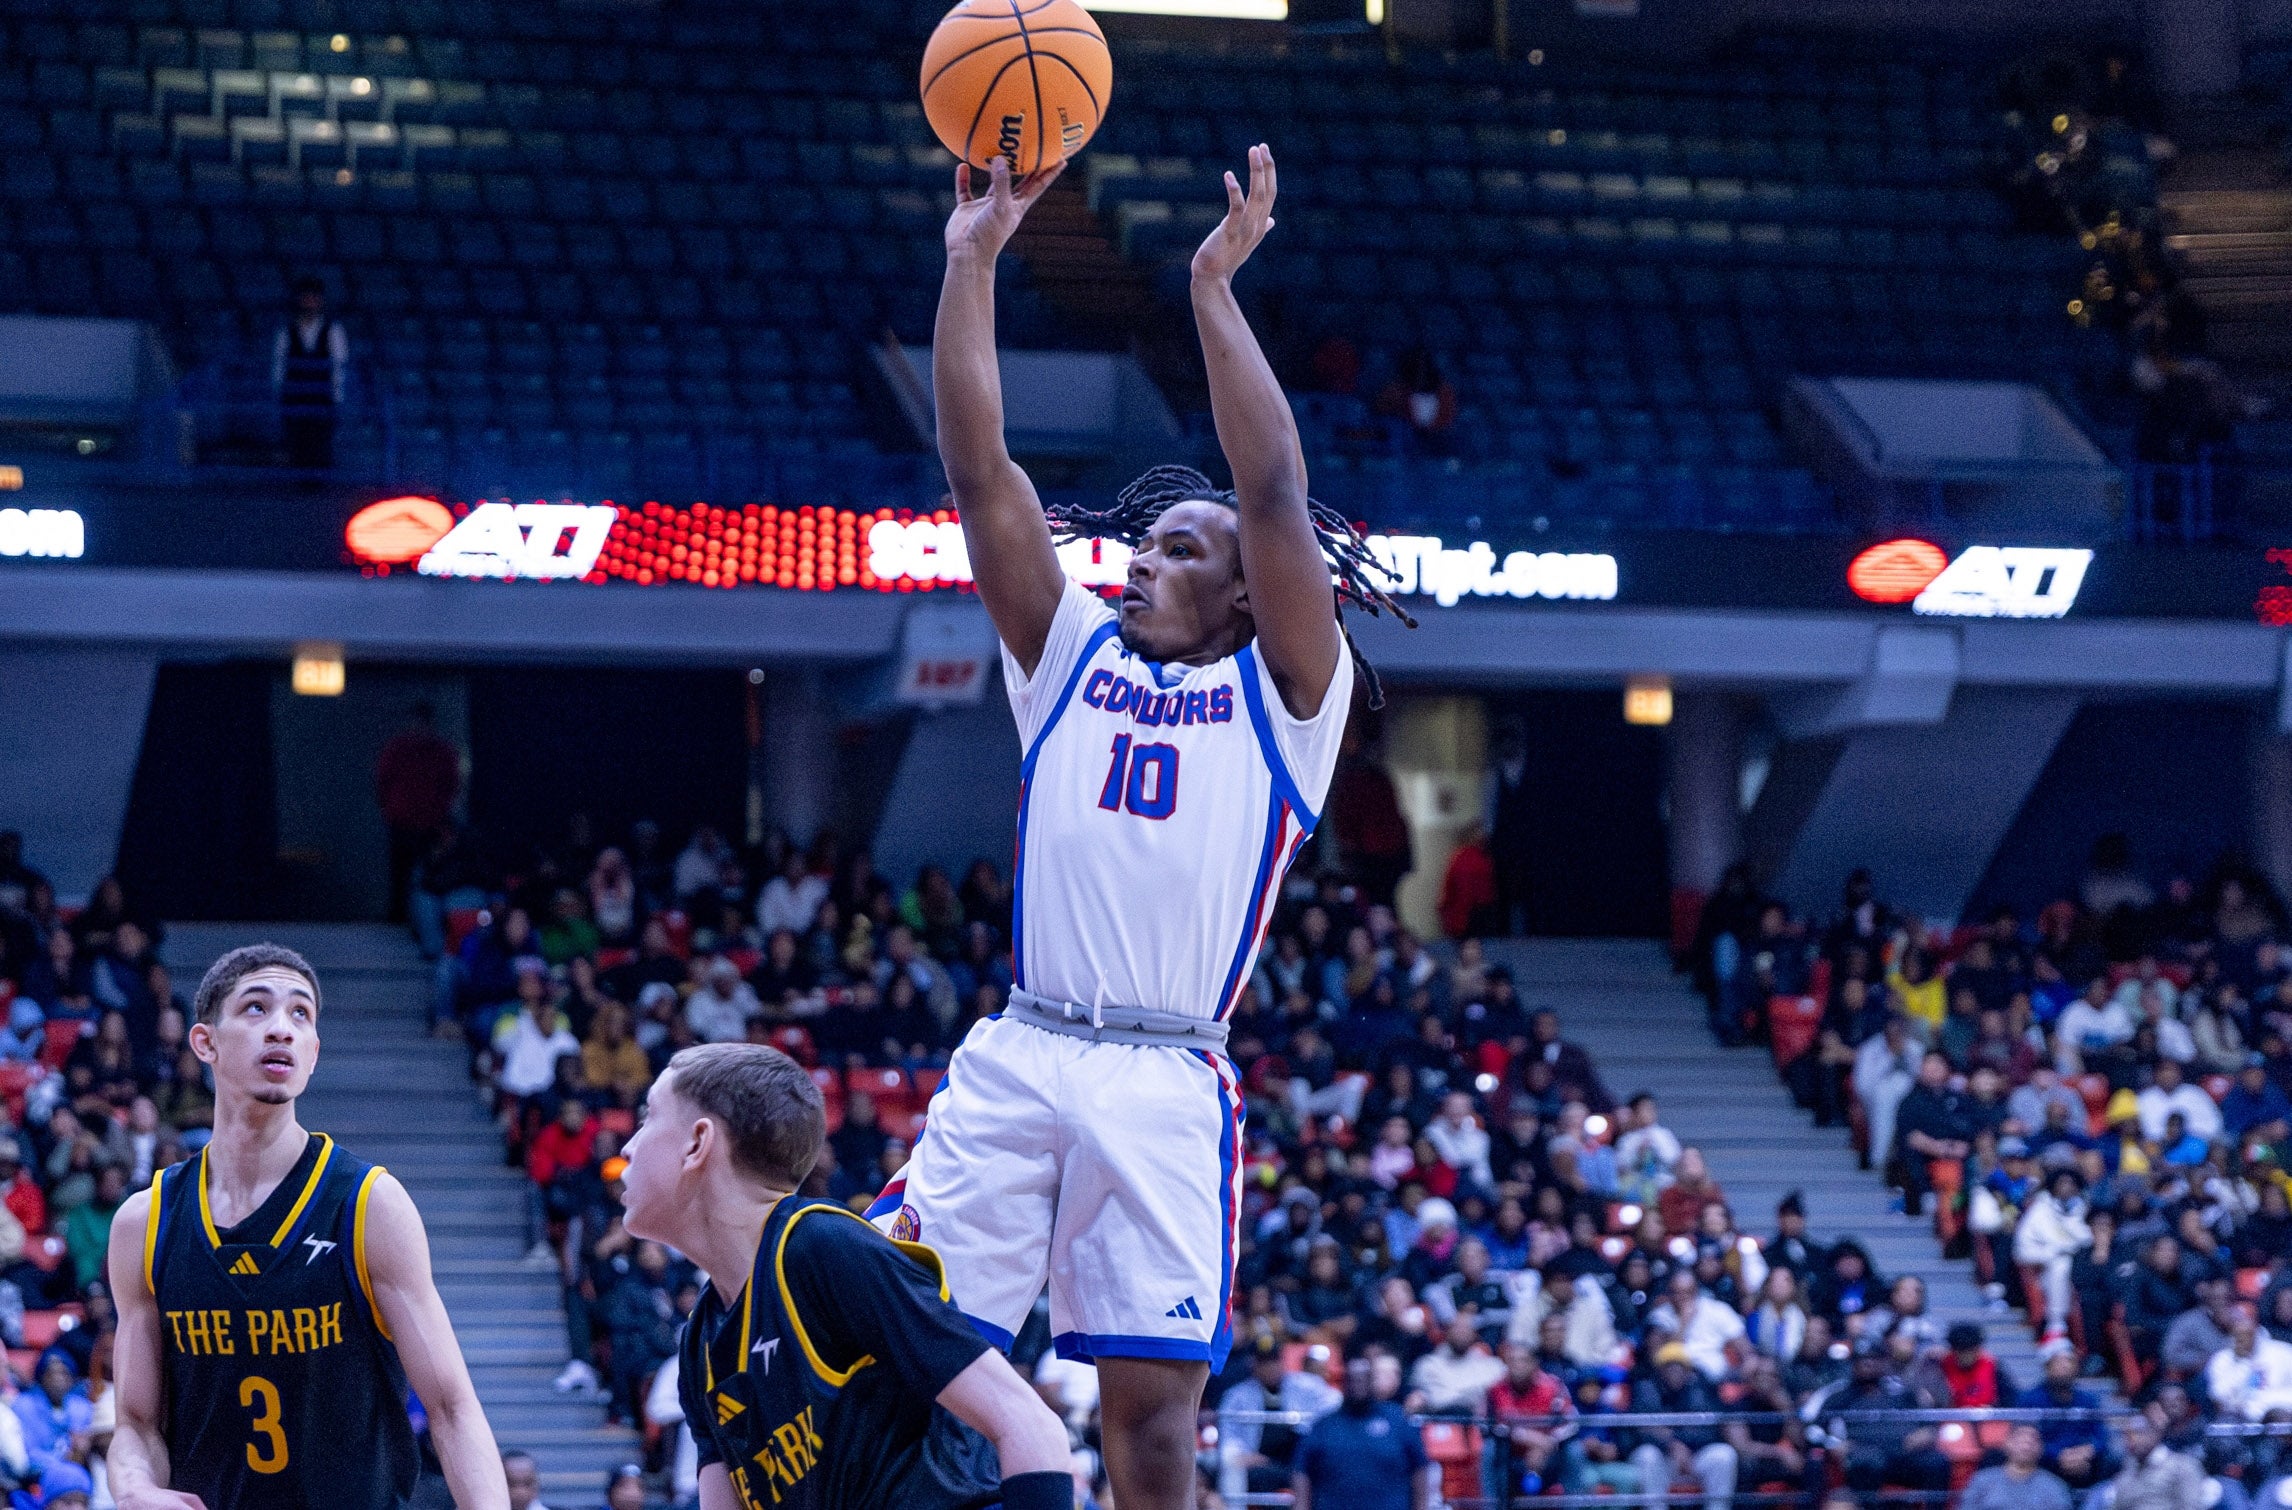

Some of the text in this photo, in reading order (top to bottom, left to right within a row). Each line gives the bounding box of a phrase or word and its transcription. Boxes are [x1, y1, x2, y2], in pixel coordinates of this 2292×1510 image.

[419, 502, 618, 578] ATI
[1912, 545, 2094, 618] ATI
[1083, 668, 1233, 727] CONDORS
[1097, 732, 1180, 820] 10
[166, 1301, 343, 1355] THE PARK
[239, 1376, 289, 1474] 3
